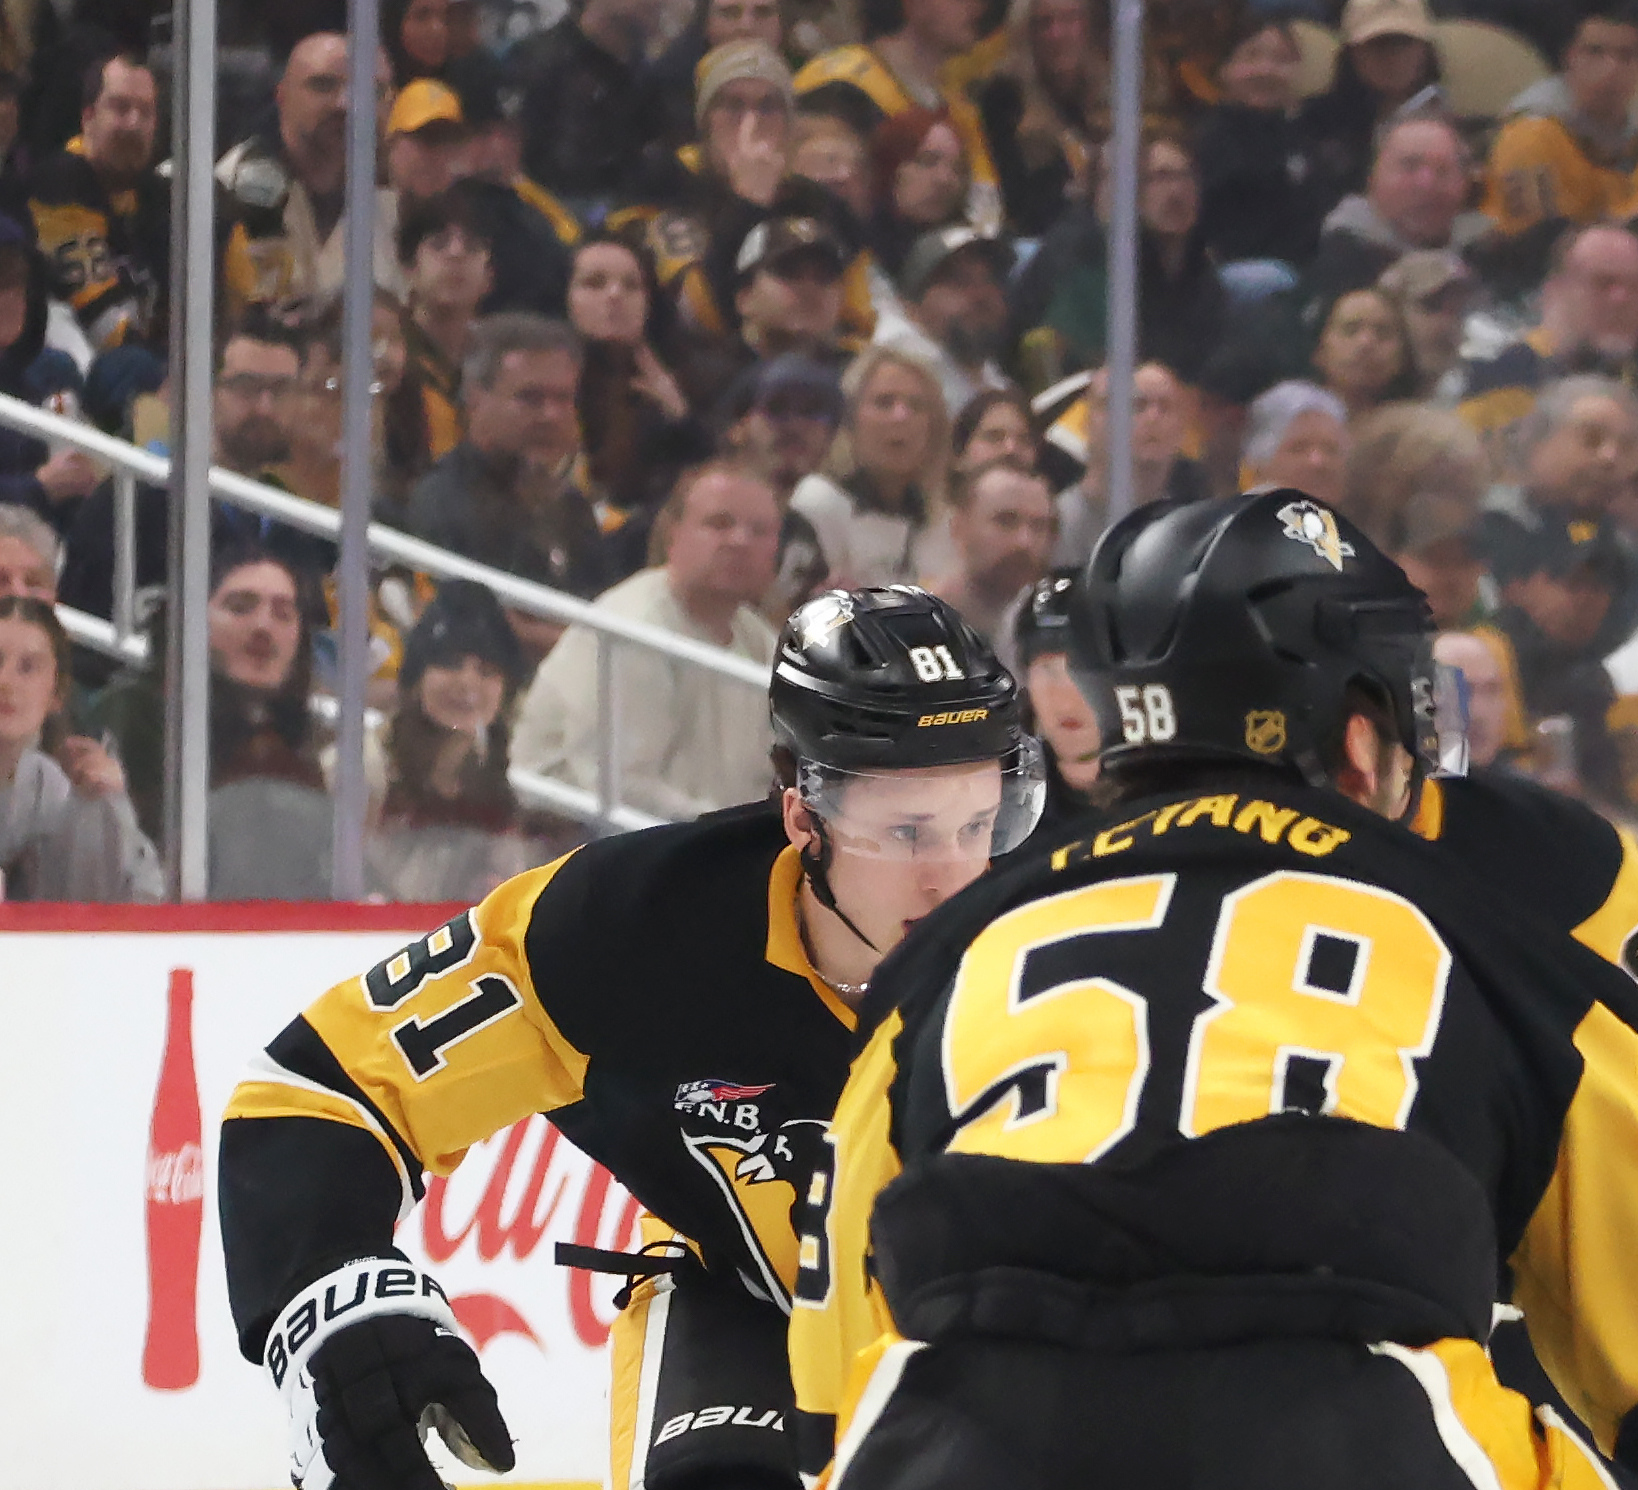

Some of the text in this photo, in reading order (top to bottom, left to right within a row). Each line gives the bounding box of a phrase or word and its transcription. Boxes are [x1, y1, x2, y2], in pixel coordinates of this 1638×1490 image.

[909, 644, 965, 682] 81
[917, 707, 990, 727] BAUER
[1114, 683, 1177, 743] 58
[360, 906, 525, 1084] 81
[941, 869, 1453, 1165] 58
[267, 1268, 451, 1390] BAUER
